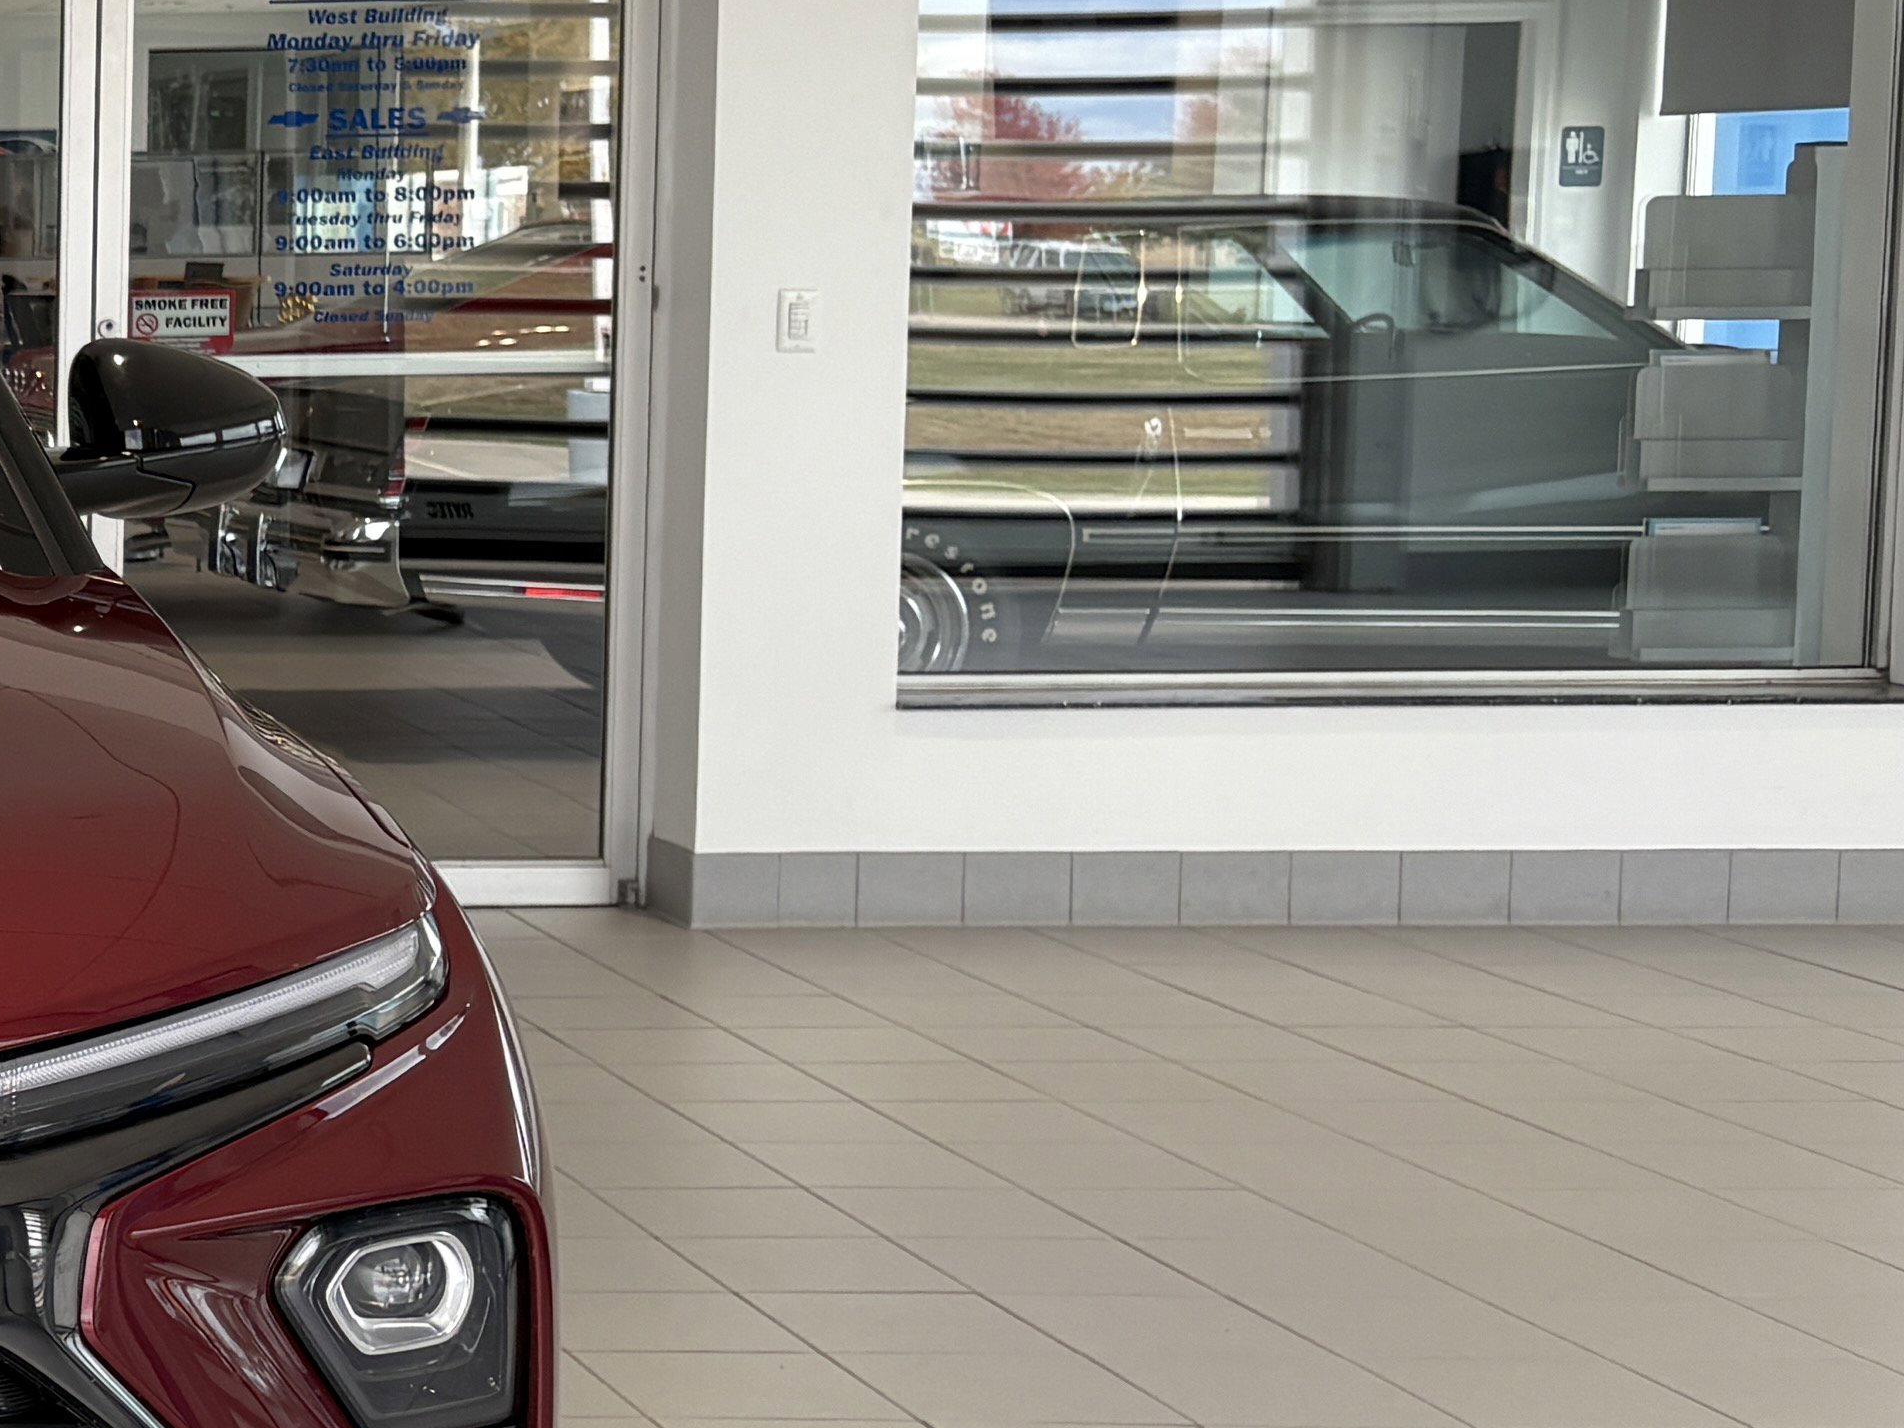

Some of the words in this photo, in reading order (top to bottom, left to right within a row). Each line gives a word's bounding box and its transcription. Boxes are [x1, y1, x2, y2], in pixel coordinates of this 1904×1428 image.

[308, 9, 361, 25] West
[364, 6, 449, 27] Building
[267, 33, 353, 52] Monday
[360, 31, 404, 49] thru
[412, 30, 481, 50] Friday
[367, 58, 386, 71] to
[328, 107, 427, 131] SALES
[309, 145, 354, 160] East
[361, 143, 444, 164] Building
[337, 167, 404, 183] Monday
[365, 188, 385, 203] to
[394, 187, 475, 204] 8:00pm
[288, 212, 361, 228] Tuesday
[366, 211, 403, 225] thru
[408, 210, 463, 227] Friday
[275, 235, 355, 251] 9:00am
[364, 235, 385, 250] to
[393, 233, 475, 251] 6:00pm
[330, 263, 414, 279] Saturday
[274, 281, 355, 297] 9:00am
[363, 281, 385, 296] to
[393, 279, 474, 297] 4:00pm
[134, 299, 187, 310] SMOKE
[191, 298, 229, 310] FREE
[165, 316, 227, 328] FACILITY
[313, 311, 370, 323] Closed
[906, 527, 997, 643] restone
